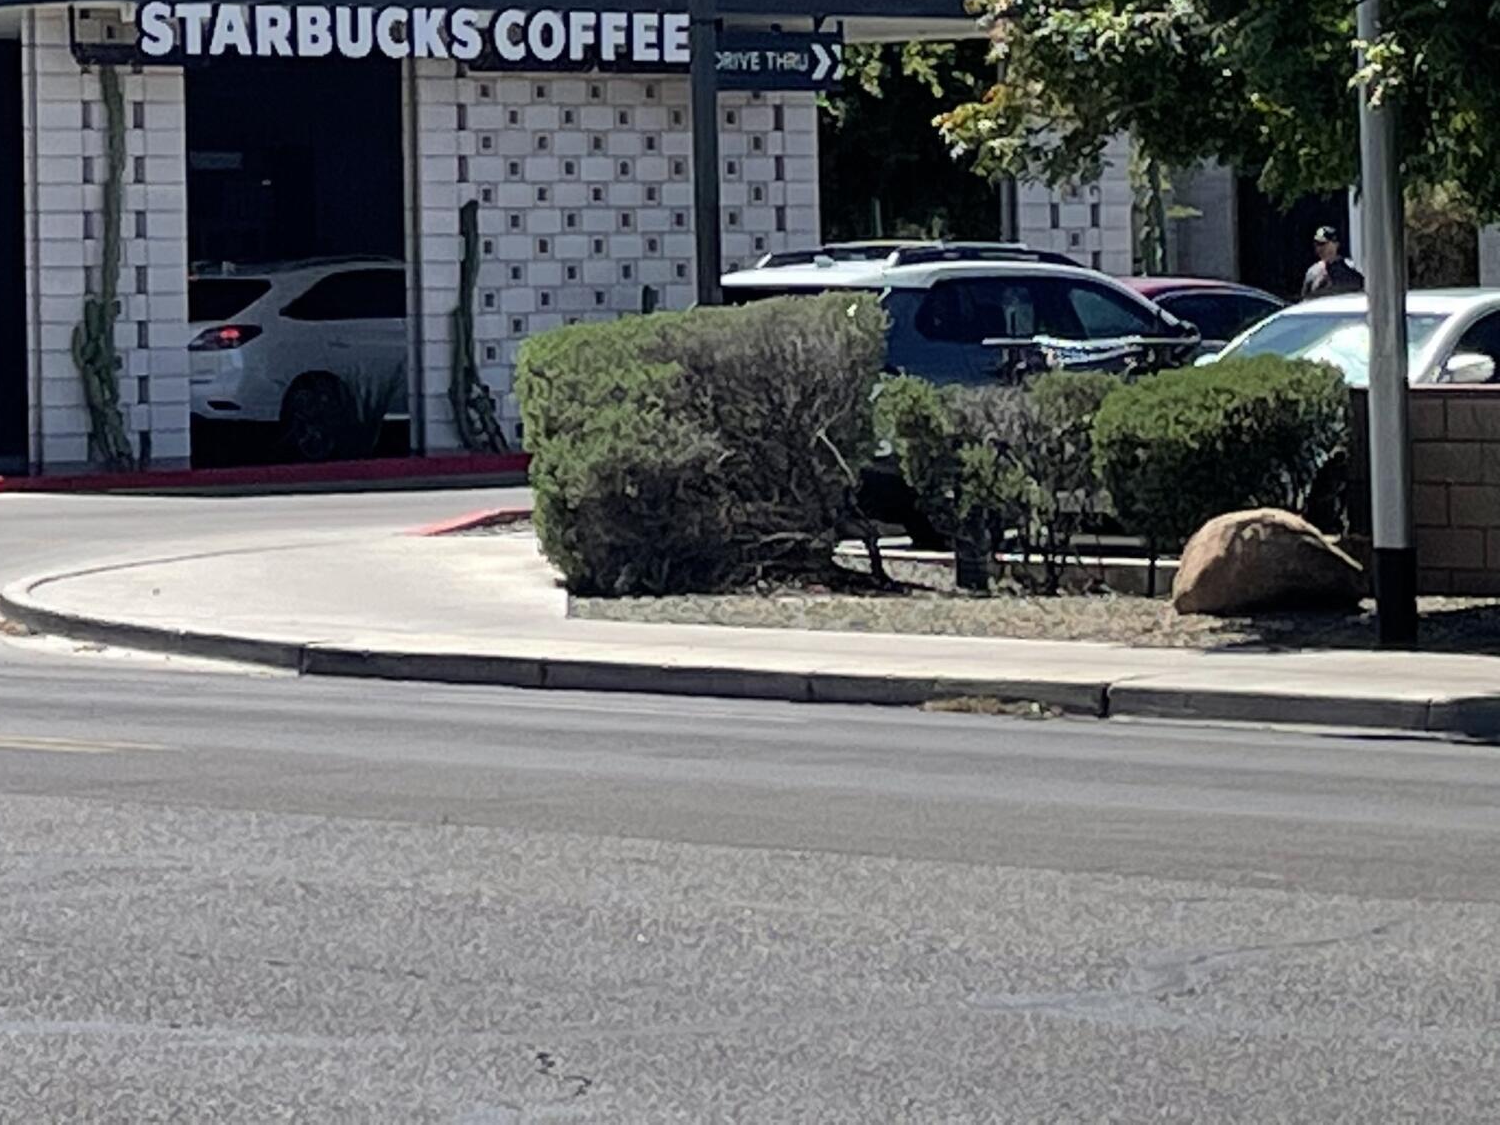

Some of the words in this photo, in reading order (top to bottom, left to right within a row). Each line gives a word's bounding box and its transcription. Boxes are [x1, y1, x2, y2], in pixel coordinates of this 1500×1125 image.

[141, 1, 483, 59] STARBUCKS
[494, 9, 691, 63] COFFEE
[765, 50, 809, 72] THRU
